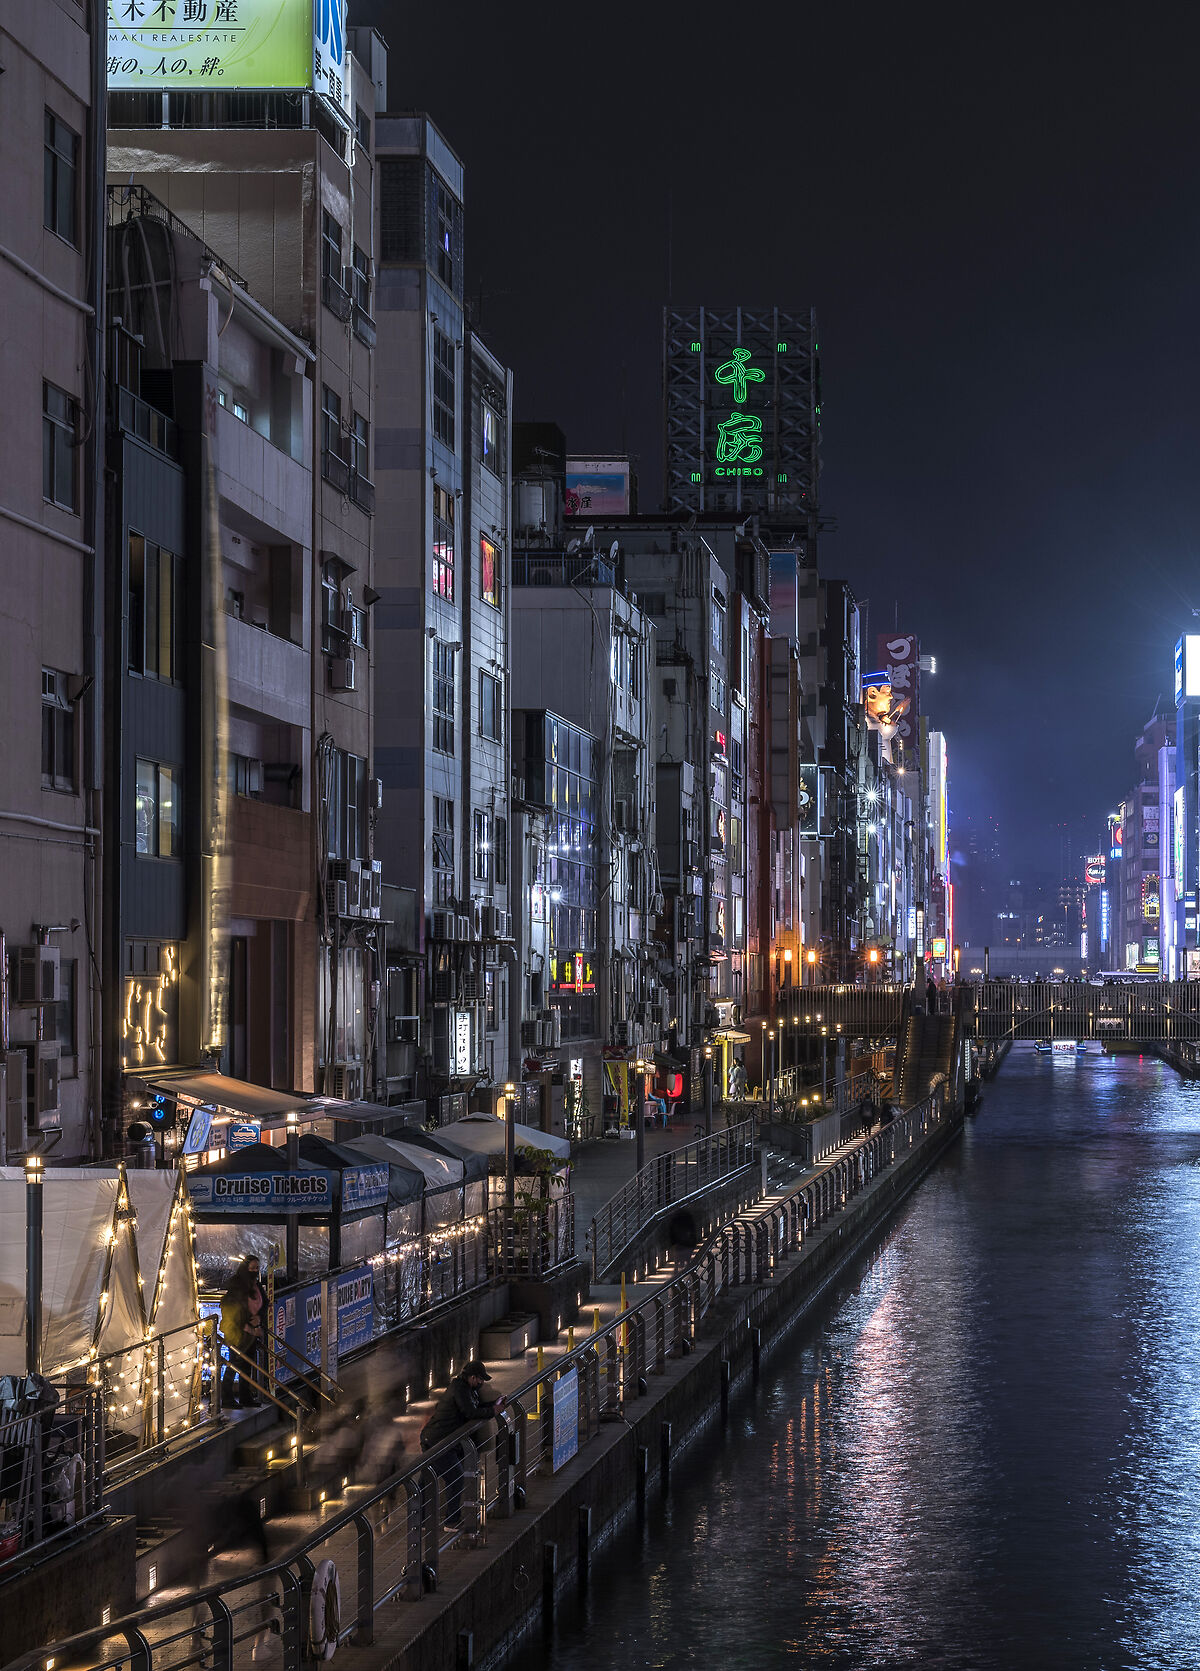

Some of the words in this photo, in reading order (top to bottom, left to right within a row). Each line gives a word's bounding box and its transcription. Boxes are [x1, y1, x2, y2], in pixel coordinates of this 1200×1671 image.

[107, 0, 239, 22] 木不動産
[152, 34, 237, 43] REALESTATE
[715, 467, 763, 477] CHIBO
[215, 1176, 271, 1196] Cruise
[272, 1175, 328, 1196] Tickets
